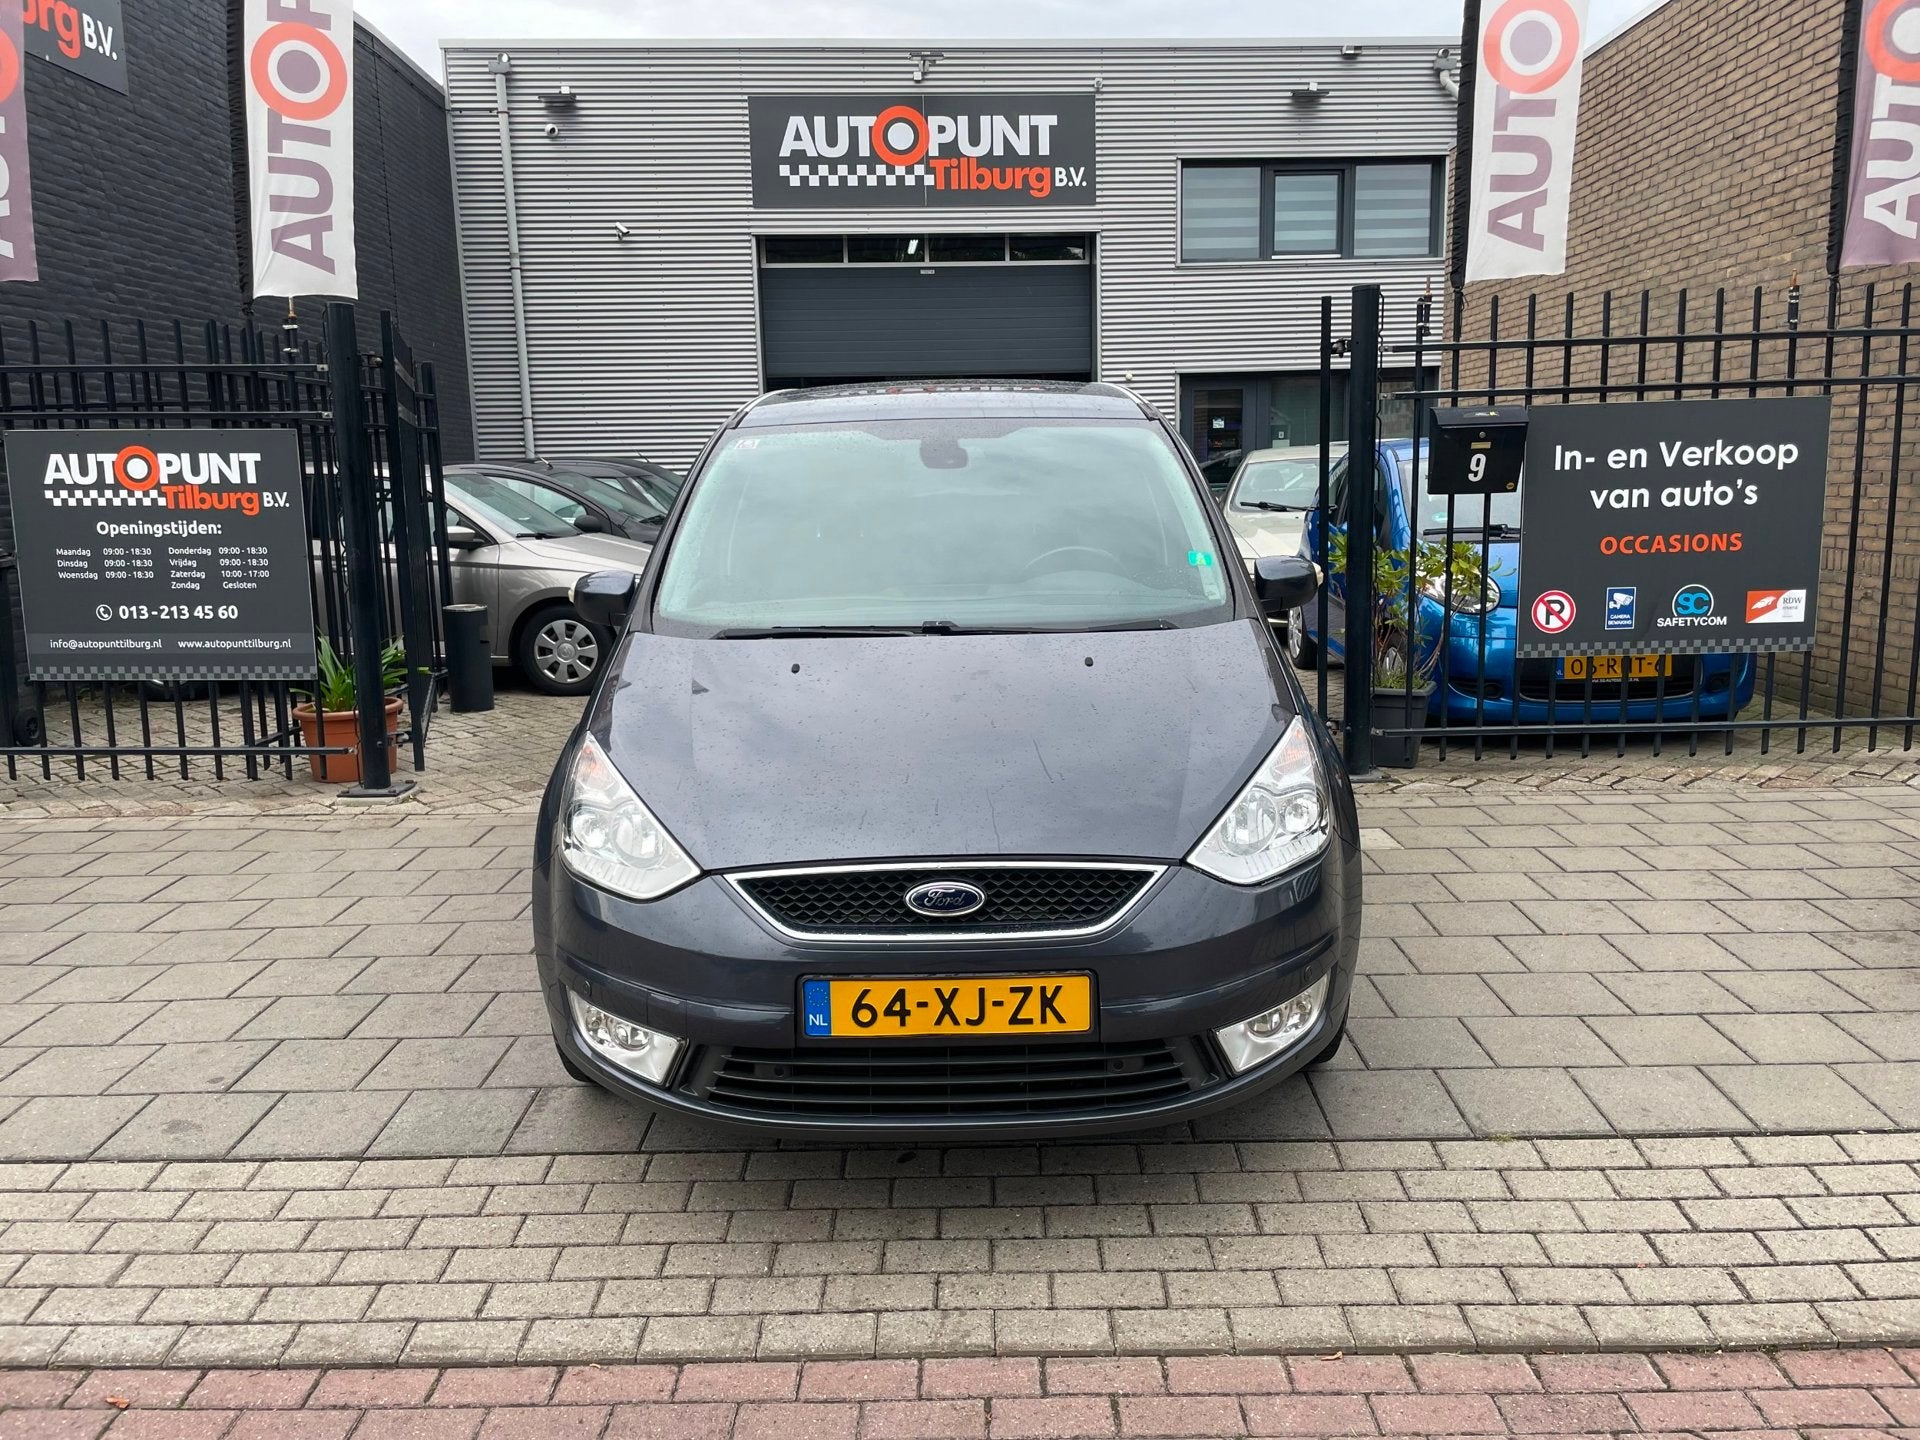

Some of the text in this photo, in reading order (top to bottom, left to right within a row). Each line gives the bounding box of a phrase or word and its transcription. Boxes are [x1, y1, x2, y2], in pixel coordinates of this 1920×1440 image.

[82, 12, 118, 60] B.V.
[1483, 0, 1580, 252] AUTO
[779, 105, 1058, 167] AUTOPUNT
[929, 157, 1087, 198] Tilburg B.V.
[1554, 440, 1799, 471] In- en Verkoop
[43, 445, 262, 491] AUTOPUNT
[1467, 453, 1487, 482] 9
[161, 485, 290, 516] Tilburg B.V.
[1590, 478, 1758, 510] van auto's
[96, 520, 222, 537] Openingstijden:
[56, 548, 91, 557] Maandag
[168, 547, 212, 556] Donderdag
[218, 547, 240, 555] 09:00
[246, 547, 268, 555] 18:30
[1599, 532, 1744, 555] OCCASIONS
[57, 559, 88, 569] Dinsdag
[104, 559, 126, 567] 09:00
[132, 559, 153, 567] 18:30
[169, 558, 197, 568] Vrijdag
[219, 558, 241, 566] 09:00
[247, 558, 269, 566] 18:30
[58, 571, 98, 580] Woensdag
[105, 571, 127, 579] 09:00
[133, 571, 154, 579] 18:30
[170, 570, 206, 579] Zaterdag
[221, 570, 242, 578] 10:00
[248, 570, 270, 578] 17:00
[171, 581, 257, 591] Zondag Gesloten
[194, 605, 214, 619] 45
[218, 605, 239, 619] 60
[1656, 616, 1728, 627] SAFETYCOM
[50, 638, 292, 650] info@autopunttilburg.nl www.autopunttilburg.nl
[923, 888, 966, 907] Ford
[808, 985, 1067, 1028] NL 64-XJ-ZK
